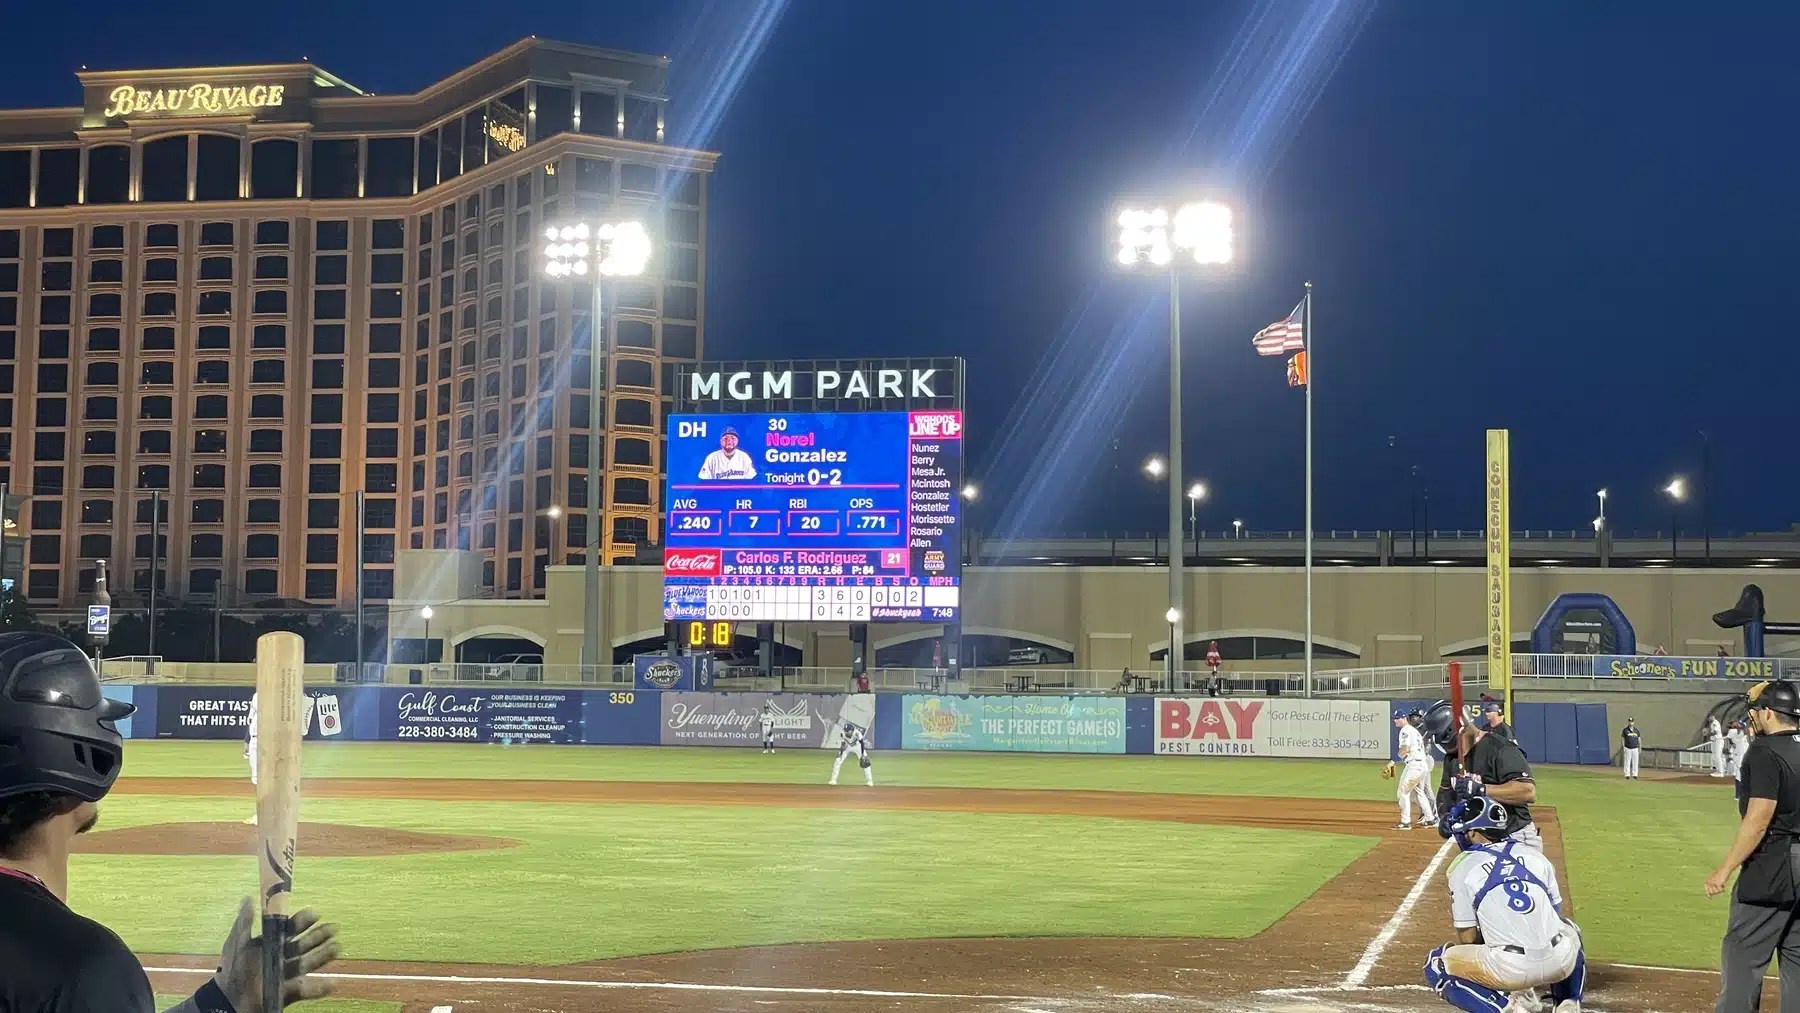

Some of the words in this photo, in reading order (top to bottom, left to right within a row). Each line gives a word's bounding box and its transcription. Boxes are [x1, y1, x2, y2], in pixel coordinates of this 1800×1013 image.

[105, 86, 188, 117] BEAU
[187, 84, 285, 112] RIVAGE
[691, 371, 792, 401] MGM
[817, 369, 937, 399] PARK
[678, 421, 707, 438] DH
[768, 418, 787, 431] 30
[942, 422, 960, 436] UP
[766, 432, 815, 447] Norel
[911, 443, 940, 453] Nunez
[765, 448, 847, 463] Gonzalez
[911, 455, 935, 466] Berry
[765, 472, 805, 485] Tonight
[807, 468, 842, 486] 0-2
[911, 467, 934, 476] Mesa
[934, 467, 946, 476] Jr.
[911, 491, 950, 500] Gonzalez
[673, 499, 697, 510] AVG
[736, 499, 752, 510] HR
[789, 498, 808, 509] RBI
[850, 498, 873, 509] OPS
[911, 502, 950, 512] Hostetler
[1490, 461, 1501, 554] CONECUH
[678, 516, 711, 530] .240
[749, 516, 759, 529] 7
[801, 516, 820, 529] 20
[856, 516, 886, 529] .771
[910, 514, 956, 524] Morissette
[910, 526, 943, 536] Rosario
[910, 538, 932, 548] Allen
[736, 552, 780, 564] Carlos
[783, 552, 793, 564] F.
[797, 551, 867, 566] Rodriguez
[887, 553, 901, 564] 21
[778, 565, 795, 575] 132
[710, 577, 715, 585] 1
[721, 577, 727, 585] 2
[732, 577, 739, 585] 3
[778, 577, 784, 585] 7
[818, 577, 826, 585] R
[837, 577, 844, 585] H
[856, 577, 863, 585] E
[875, 577, 883, 585] B
[893, 577, 900, 585] S
[910, 577, 919, 586] O
[929, 577, 953, 585] MPH
[710, 589, 715, 600] 1
[720, 589, 727, 600] 0
[733, 589, 738, 600] 1
[744, 589, 751, 600] 0
[756, 589, 760, 600] 1
[818, 590, 825, 600] 3
[837, 590, 844, 600] 6
[856, 590, 863, 600] 0
[876, 591, 883, 602] 0
[893, 591, 901, 602] 0
[910, 591, 918, 602] 2
[709, 605, 716, 616] 0
[720, 605, 727, 616] 0
[732, 605, 739, 616] 0
[743, 605, 750, 616] 0
[818, 606, 825, 616] 0
[837, 606, 844, 616] 4
[856, 606, 864, 616] 2
[932, 608, 953, 617] 7:48
[1491, 564, 1502, 660] SAUSAGE
[645, 666, 682, 680] Shuckers
[1611, 659, 1676, 680] Schooner's
[1681, 660, 1717, 676] FUN
[1725, 660, 1773, 677] ZONE
[609, 692, 635, 704] 350
[189, 700, 224, 711] GREAT
[320, 703, 337, 716] Lite
[398, 691, 438, 719] Gulf
[440, 695, 486, 713] Coast
[1025, 703, 1058, 716] Home
[180, 715, 210, 726] THAT
[211, 715, 236, 726] HITS
[668, 702, 759, 731] Yuengling
[775, 718, 805, 727] LIGHT
[1160, 700, 1264, 740] BAY
[1290, 711, 1311, 721] Pest
[1312, 711, 1331, 721] Call
[1333, 712, 1351, 722] The
[398, 725, 478, 738] 228-380-3484
[675, 731, 696, 739] NEXT
[697, 731, 747, 739] GENERATION
[786, 732, 807, 740] BEER
[982, 719, 1005, 734] THE
[1008, 719, 1063, 735] PERFECT
[1067, 719, 1121, 739] GAME(S)
[1160, 742, 1191, 753] PEST
[1199, 742, 1256, 754] CONTROL
[1268, 736, 1286, 747] Toll
[1287, 737, 1311, 747] Free:
[1312, 738, 1380, 750] 833-305-4229
[1503, 880, 1536, 915] 8
